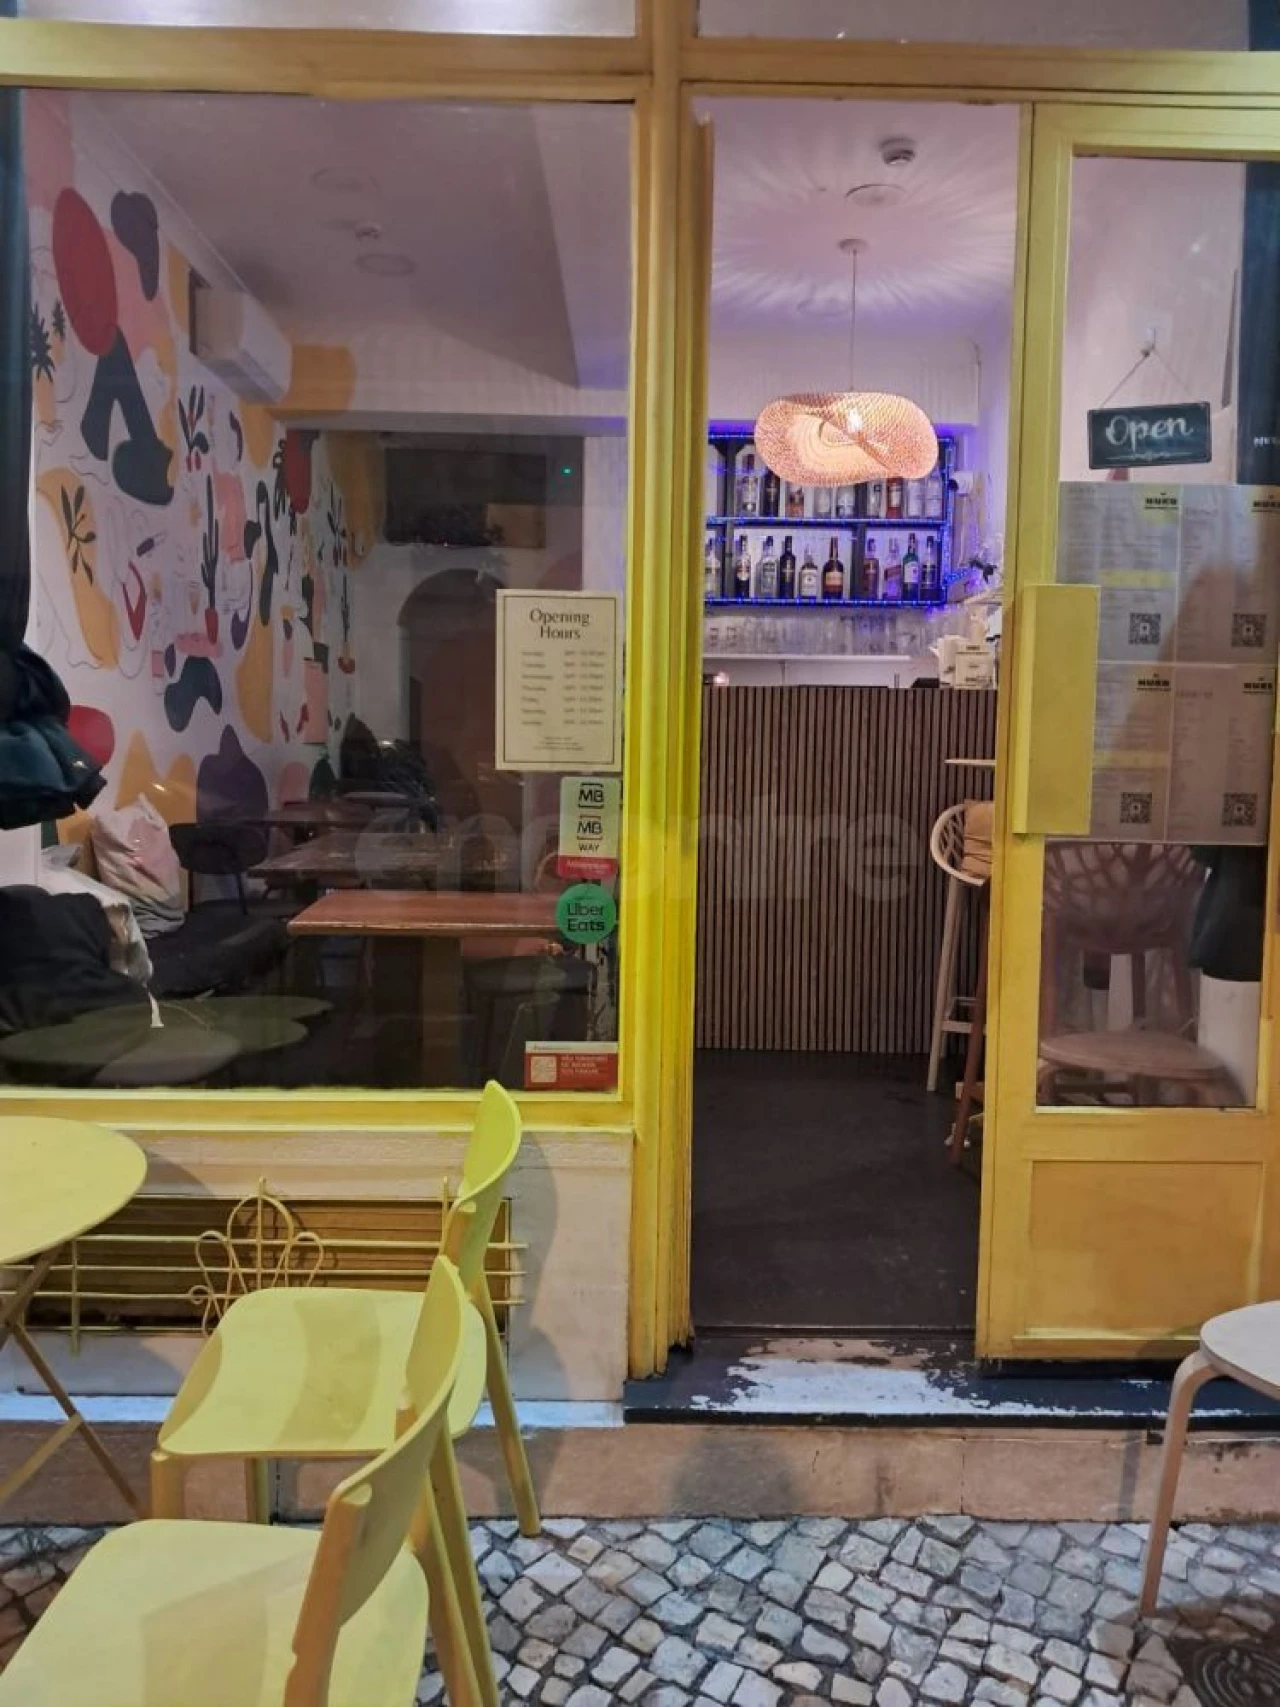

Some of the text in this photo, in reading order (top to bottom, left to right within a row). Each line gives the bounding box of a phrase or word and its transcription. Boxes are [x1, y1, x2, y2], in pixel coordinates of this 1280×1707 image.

[1105, 415, 1194, 453] Open
[529, 608, 590, 627] Opening
[540, 626, 581, 640] Hours
[578, 789, 604, 803] MB
[577, 821, 602, 835] MB
[578, 844, 600, 853] WAY
[566, 902, 605, 917] Uber
[567, 918, 605, 932] Eats
